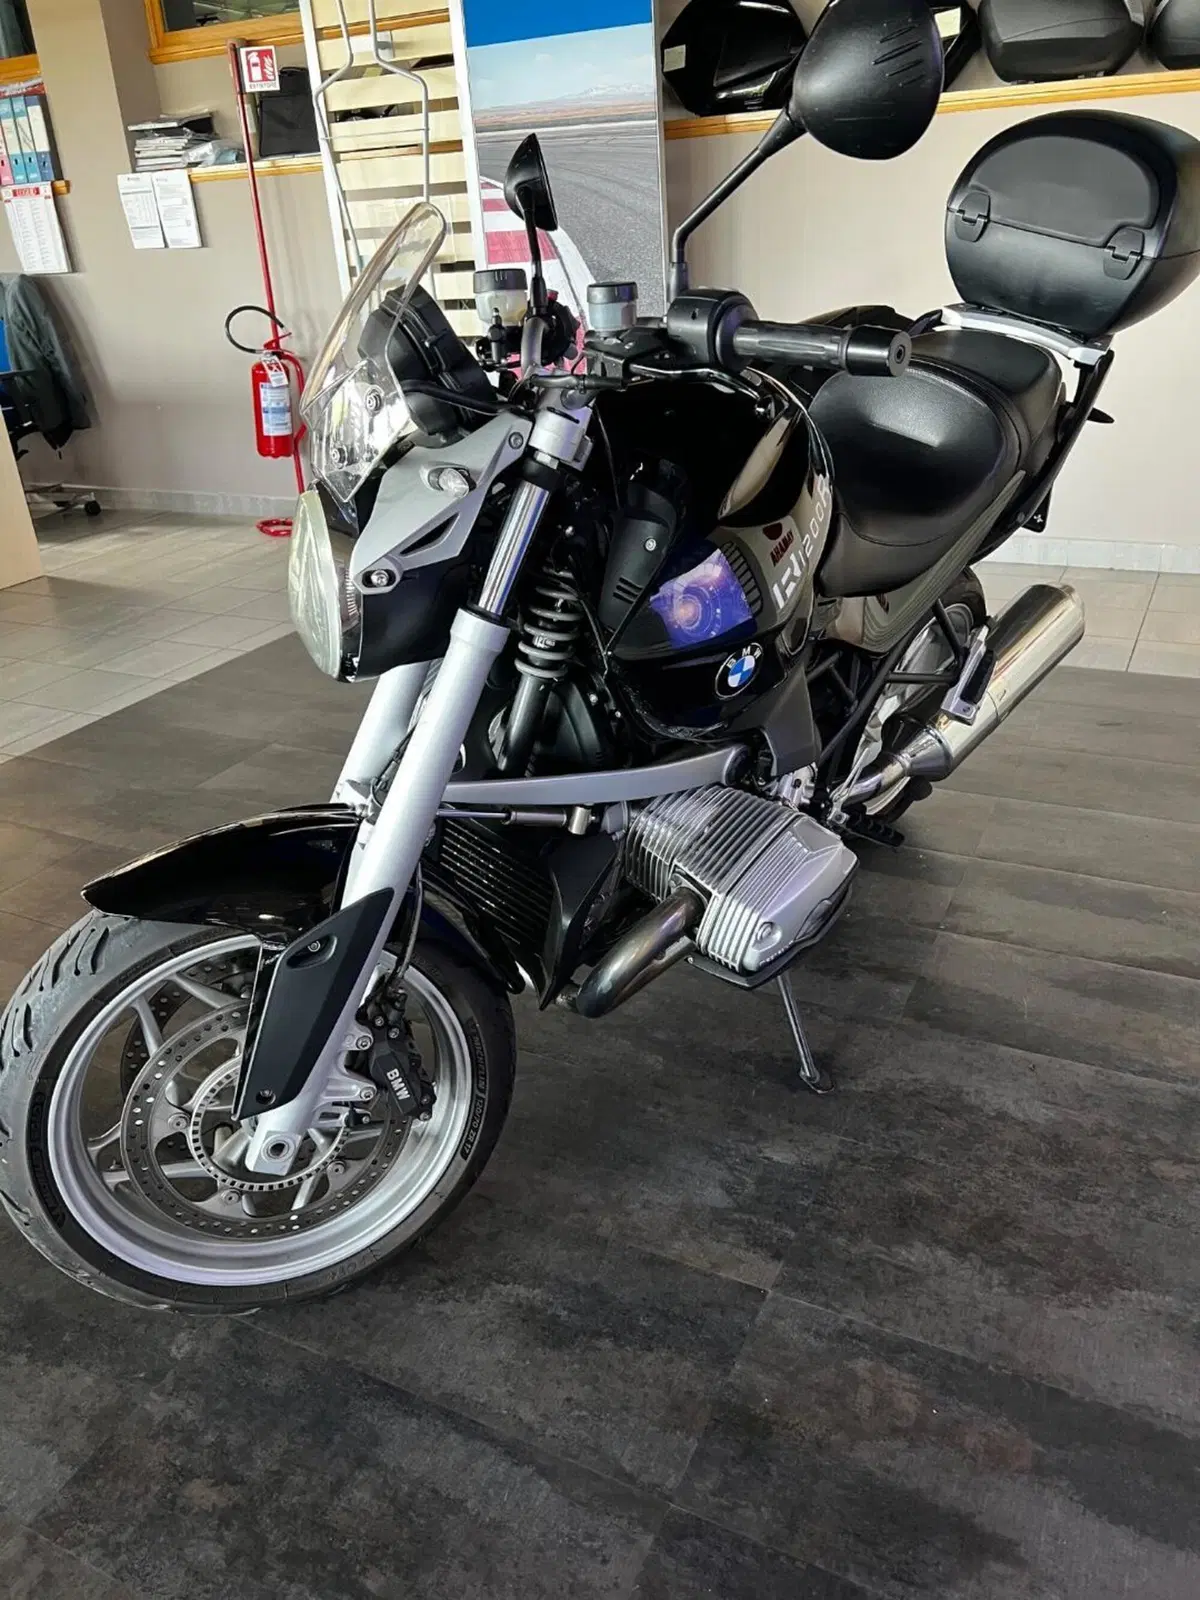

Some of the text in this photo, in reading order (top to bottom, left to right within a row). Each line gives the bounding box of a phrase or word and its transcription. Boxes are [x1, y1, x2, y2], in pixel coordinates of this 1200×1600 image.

[726, 645, 762, 669] BMW
[473, 1036, 486, 1090] MICHELIN
[386, 1068, 411, 1100] BMW
[472, 1099, 484, 1128] 120/70
